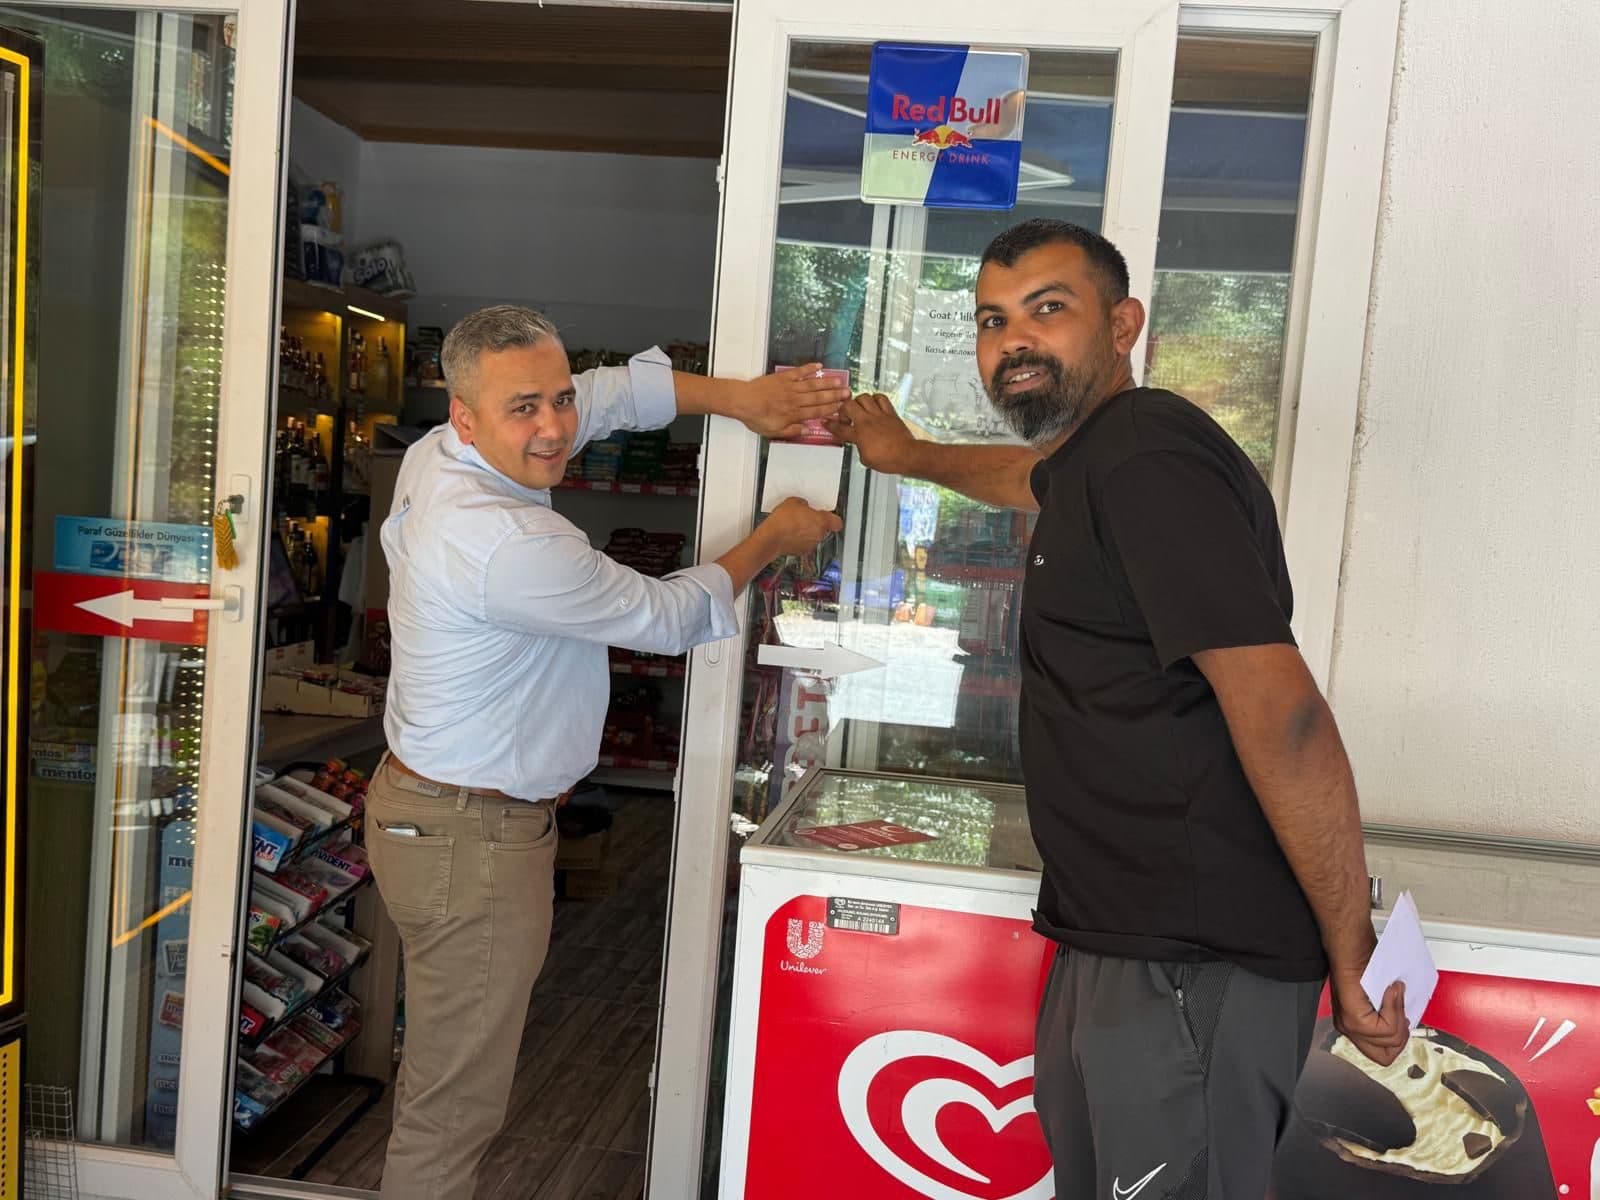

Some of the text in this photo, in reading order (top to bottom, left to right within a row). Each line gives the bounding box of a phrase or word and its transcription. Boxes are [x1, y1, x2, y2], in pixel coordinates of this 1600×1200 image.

[891, 93, 1001, 125] Red Bull
[892, 150, 990, 165] ENERGY DRINK
[929, 309, 952, 320] Goat
[78, 525, 195, 544] Paraf Güzellikler Dünyası
[780, 960, 827, 975] Unilever
